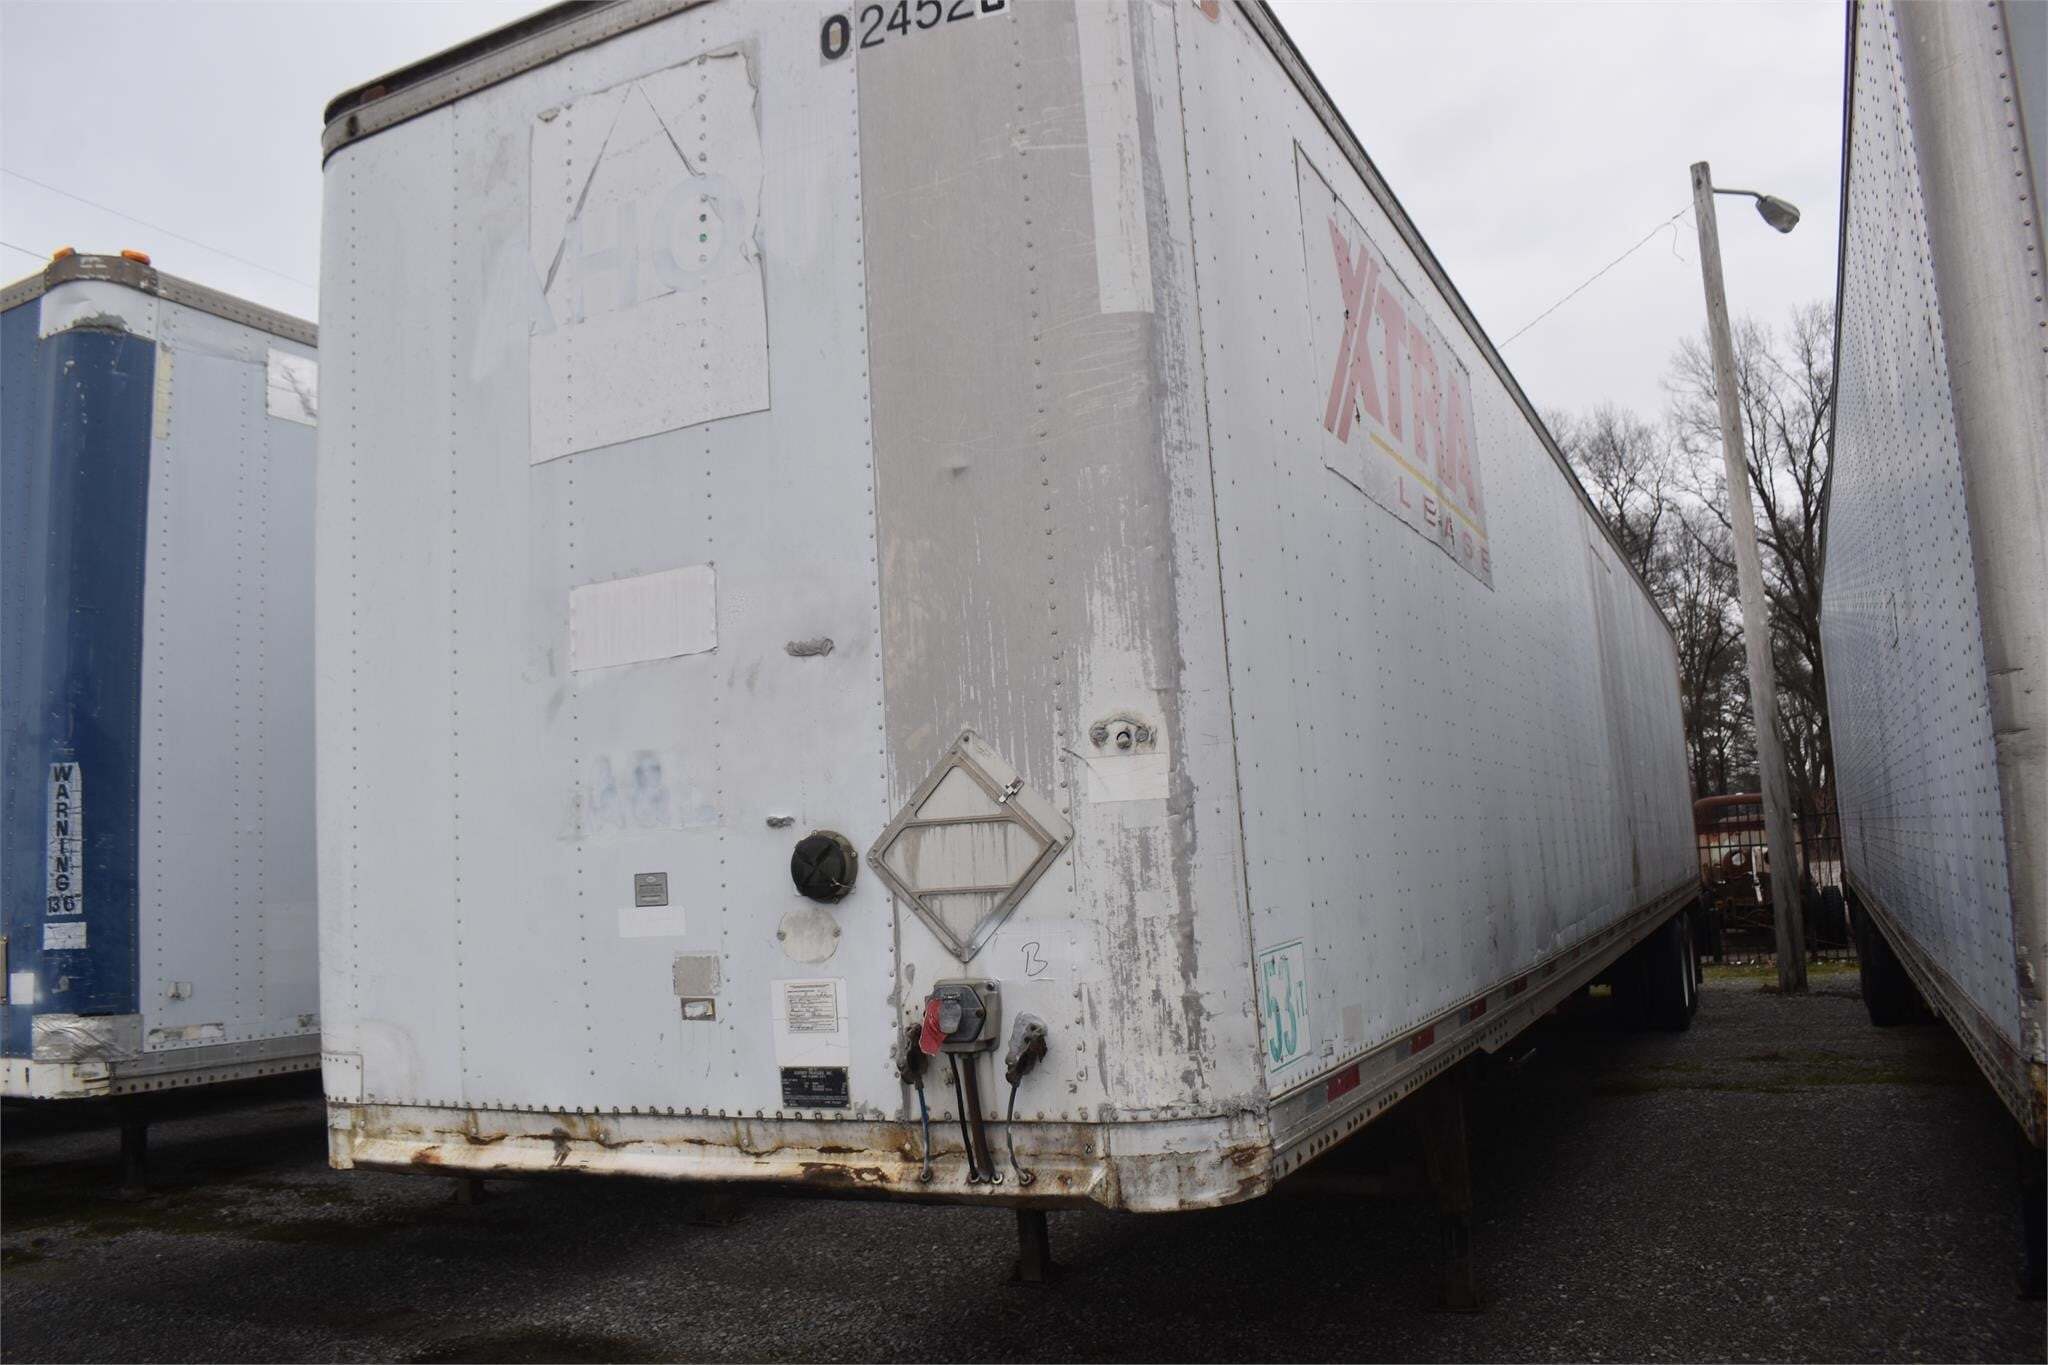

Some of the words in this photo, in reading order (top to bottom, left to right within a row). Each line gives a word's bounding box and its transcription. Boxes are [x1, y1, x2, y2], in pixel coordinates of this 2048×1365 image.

[1323, 215, 1478, 517] XTRA
[1399, 476, 1490, 574] LEASE
[54, 765, 73, 891] WARNING
